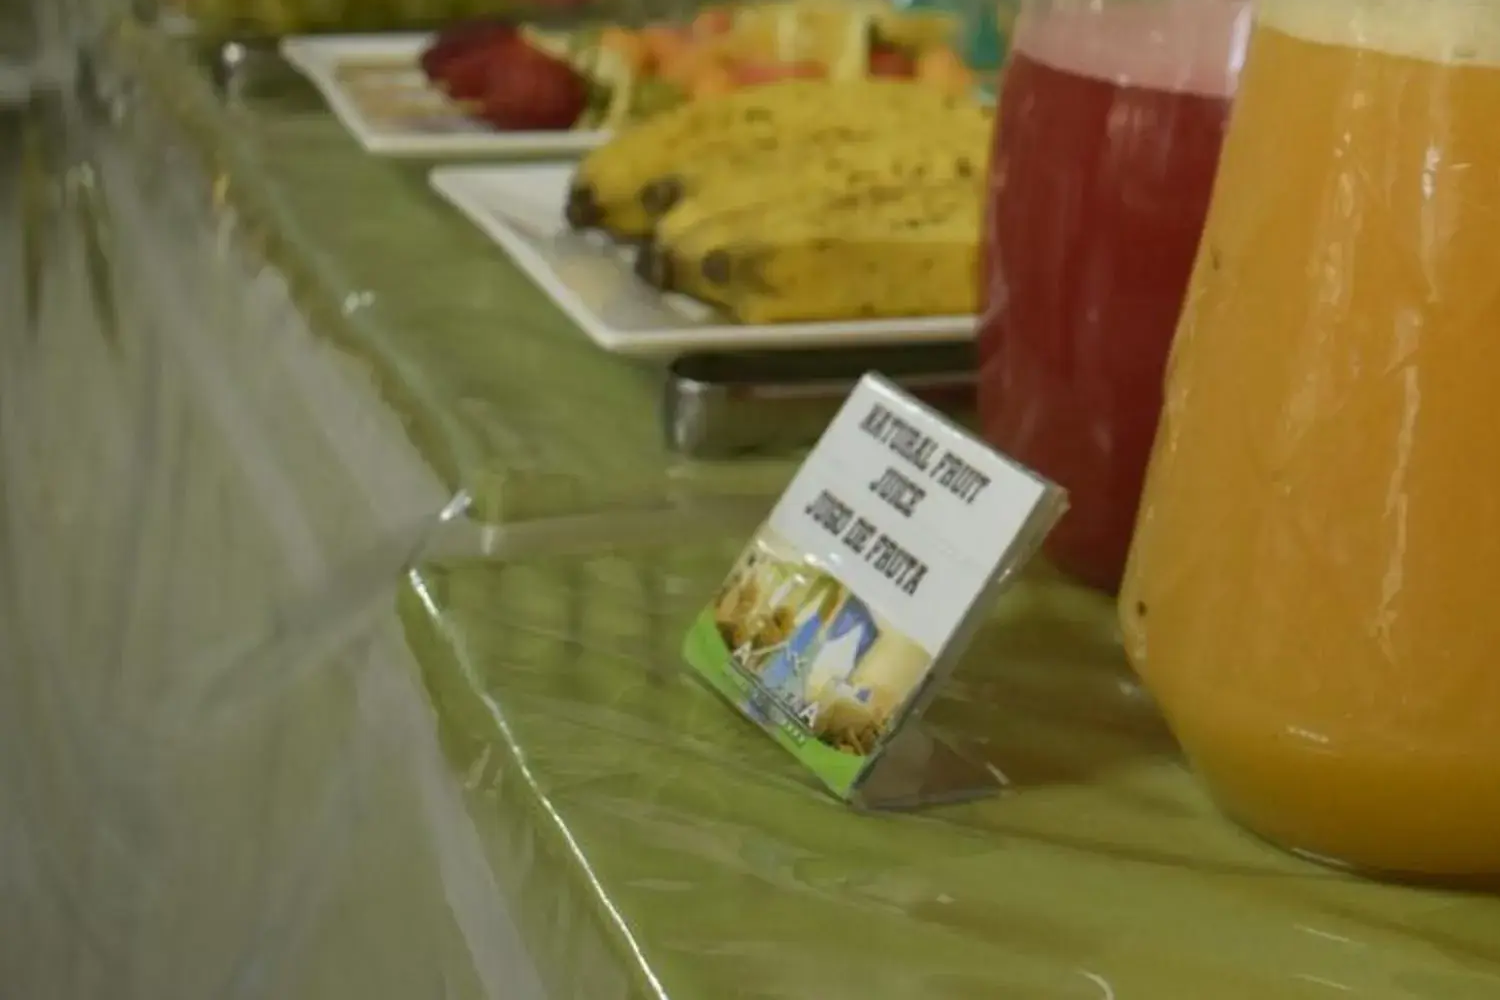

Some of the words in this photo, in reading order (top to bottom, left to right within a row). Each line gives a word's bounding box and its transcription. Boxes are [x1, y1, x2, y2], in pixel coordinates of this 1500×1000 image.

[860, 403, 939, 471] NATURAL
[929, 452, 992, 504] FRUIT
[869, 466, 926, 518] JUICE
[841, 516, 877, 554] DE
[864, 533, 929, 597] FRUTA
